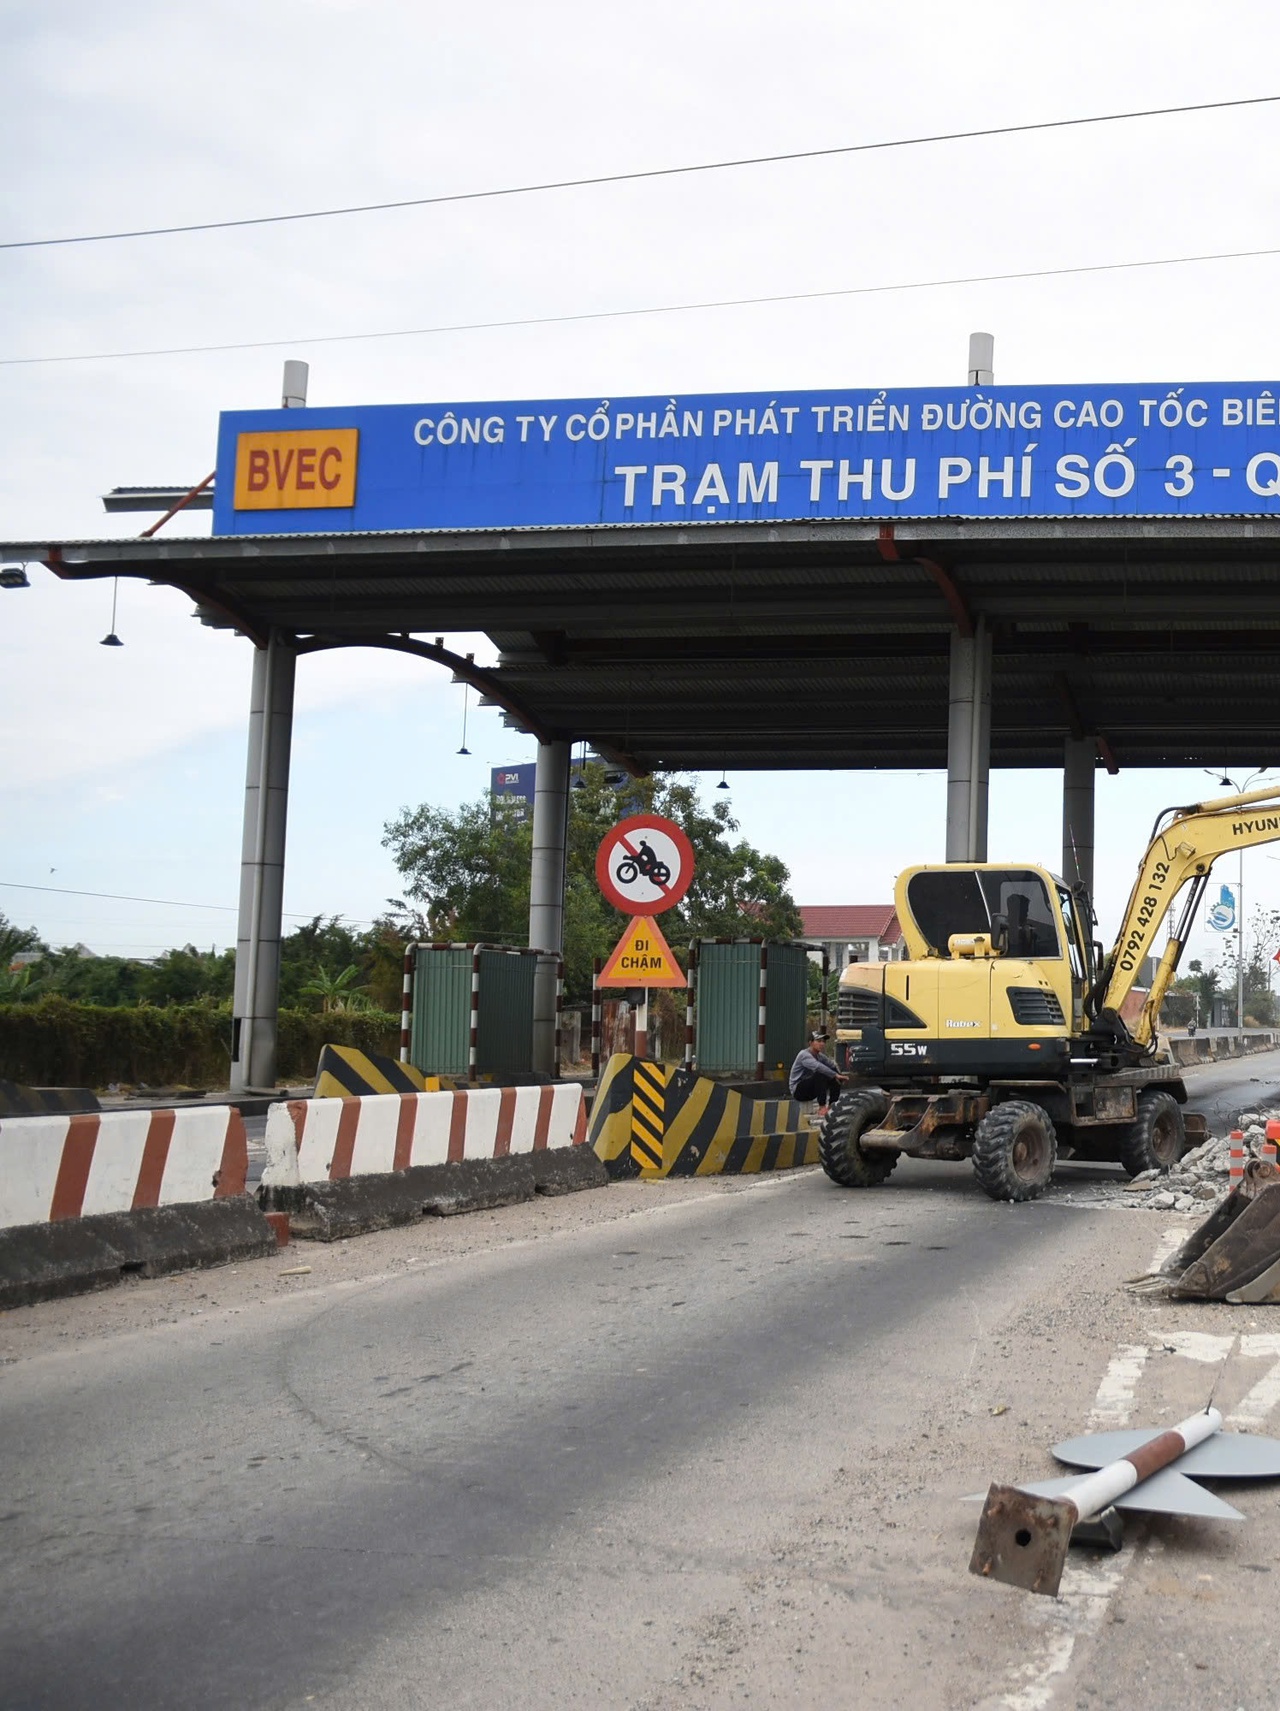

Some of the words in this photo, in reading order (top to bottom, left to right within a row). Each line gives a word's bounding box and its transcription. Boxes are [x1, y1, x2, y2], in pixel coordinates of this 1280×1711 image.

[414, 411, 505, 446] CÔNG
[515, 415, 558, 442] TY
[565, 399, 610, 441] CỔ
[615, 397, 703, 440] PHẦN
[713, 399, 800, 436] PHÁT
[811, 390, 910, 433] TRIỂN
[921, 393, 1042, 431] ĐƯỜNG
[1053, 400, 1124, 429] CAO
[1138, 387, 1208, 428] TỐC
[247, 446, 343, 492] BVEC
[614, 461, 779, 514] TRẠM
[799, 458, 916, 502] THU
[938, 443, 1038, 499] PHÍ
[1054, 437, 1138, 498] SỐ
[1164, 454, 1194, 497] 3
[1120, 930, 1145, 971] 0792
[1137, 896, 1158, 928] 428
[1148, 862, 1170, 891] 132
[621, 953, 662, 971] CHẬM
[635, 940, 649, 951] ĐI
